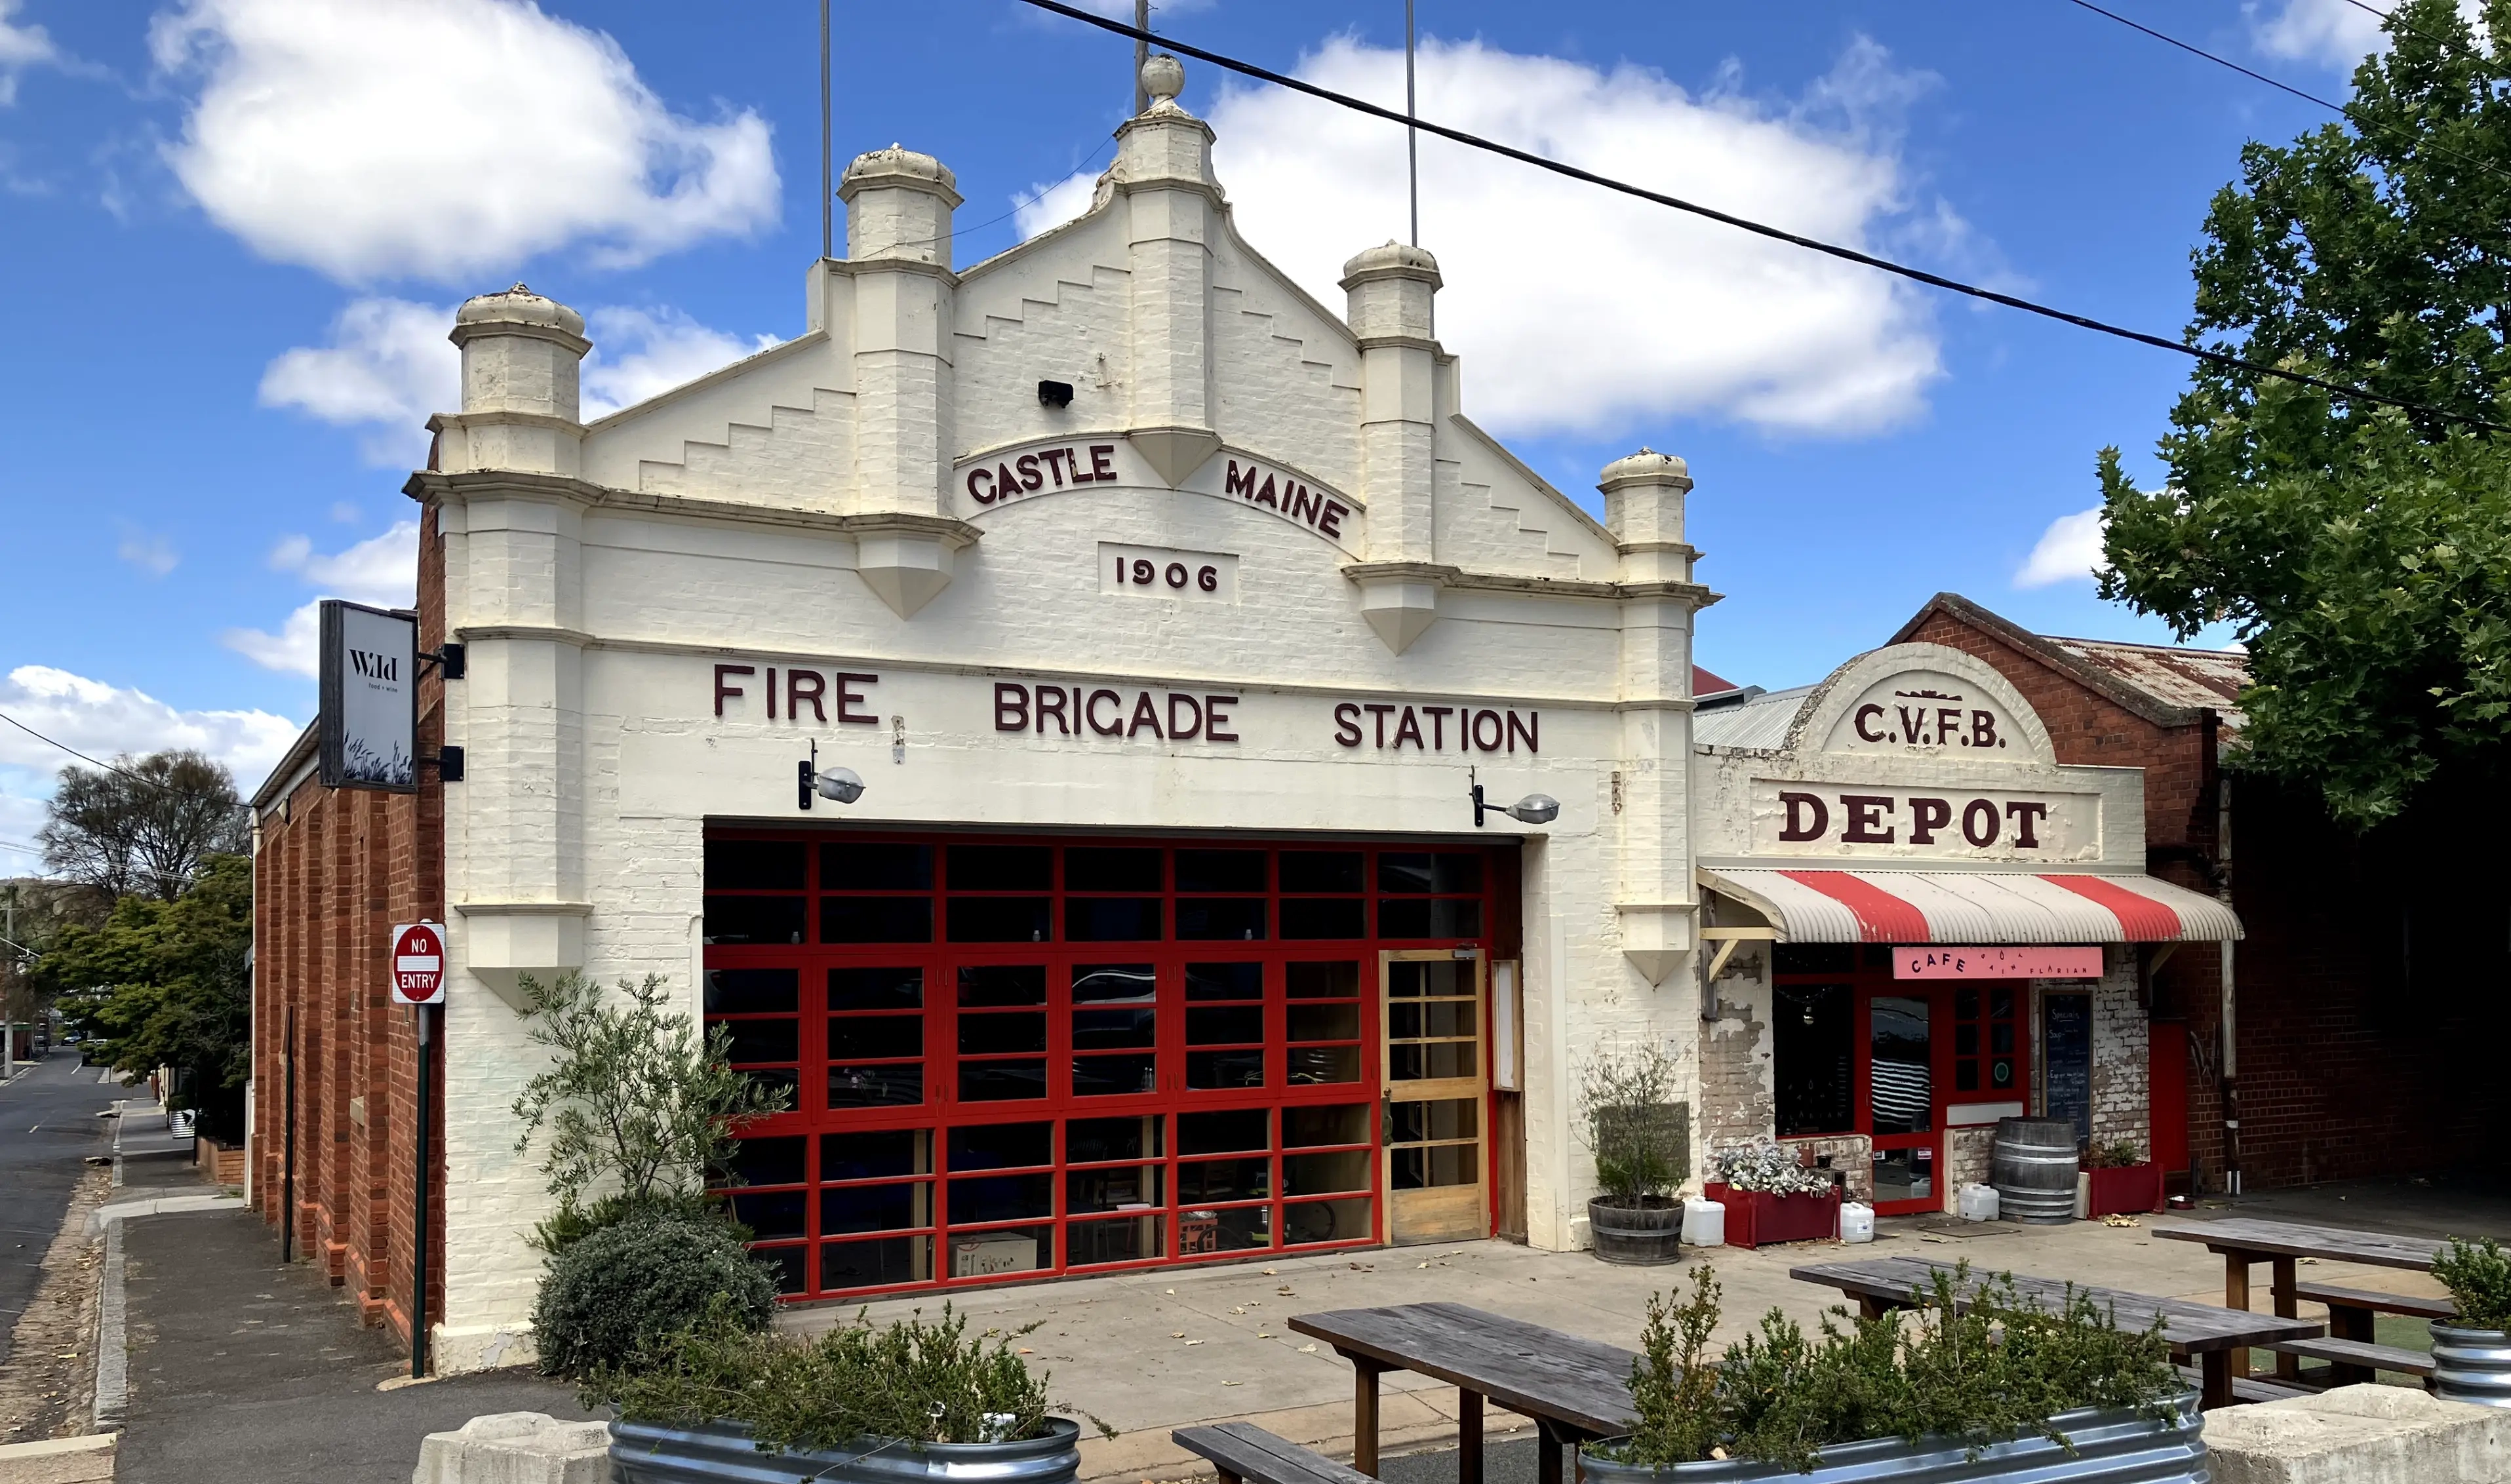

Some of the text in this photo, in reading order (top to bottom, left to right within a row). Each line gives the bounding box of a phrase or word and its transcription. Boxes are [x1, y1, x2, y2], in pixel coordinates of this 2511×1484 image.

[966, 444, 1350, 539] CASTLE MAINE
[1117, 556, 1217, 592] 1906
[349, 648, 398, 682] Wild
[714, 663, 1538, 753] FIRE BRIGADE STATION
[1853, 703, 2007, 749] C.V.F.B.
[1778, 791, 2047, 849] DEPOT
[411, 938, 427, 953] NO
[1911, 952, 1966, 973] CAFE
[401, 973, 436, 988] ENTRY
